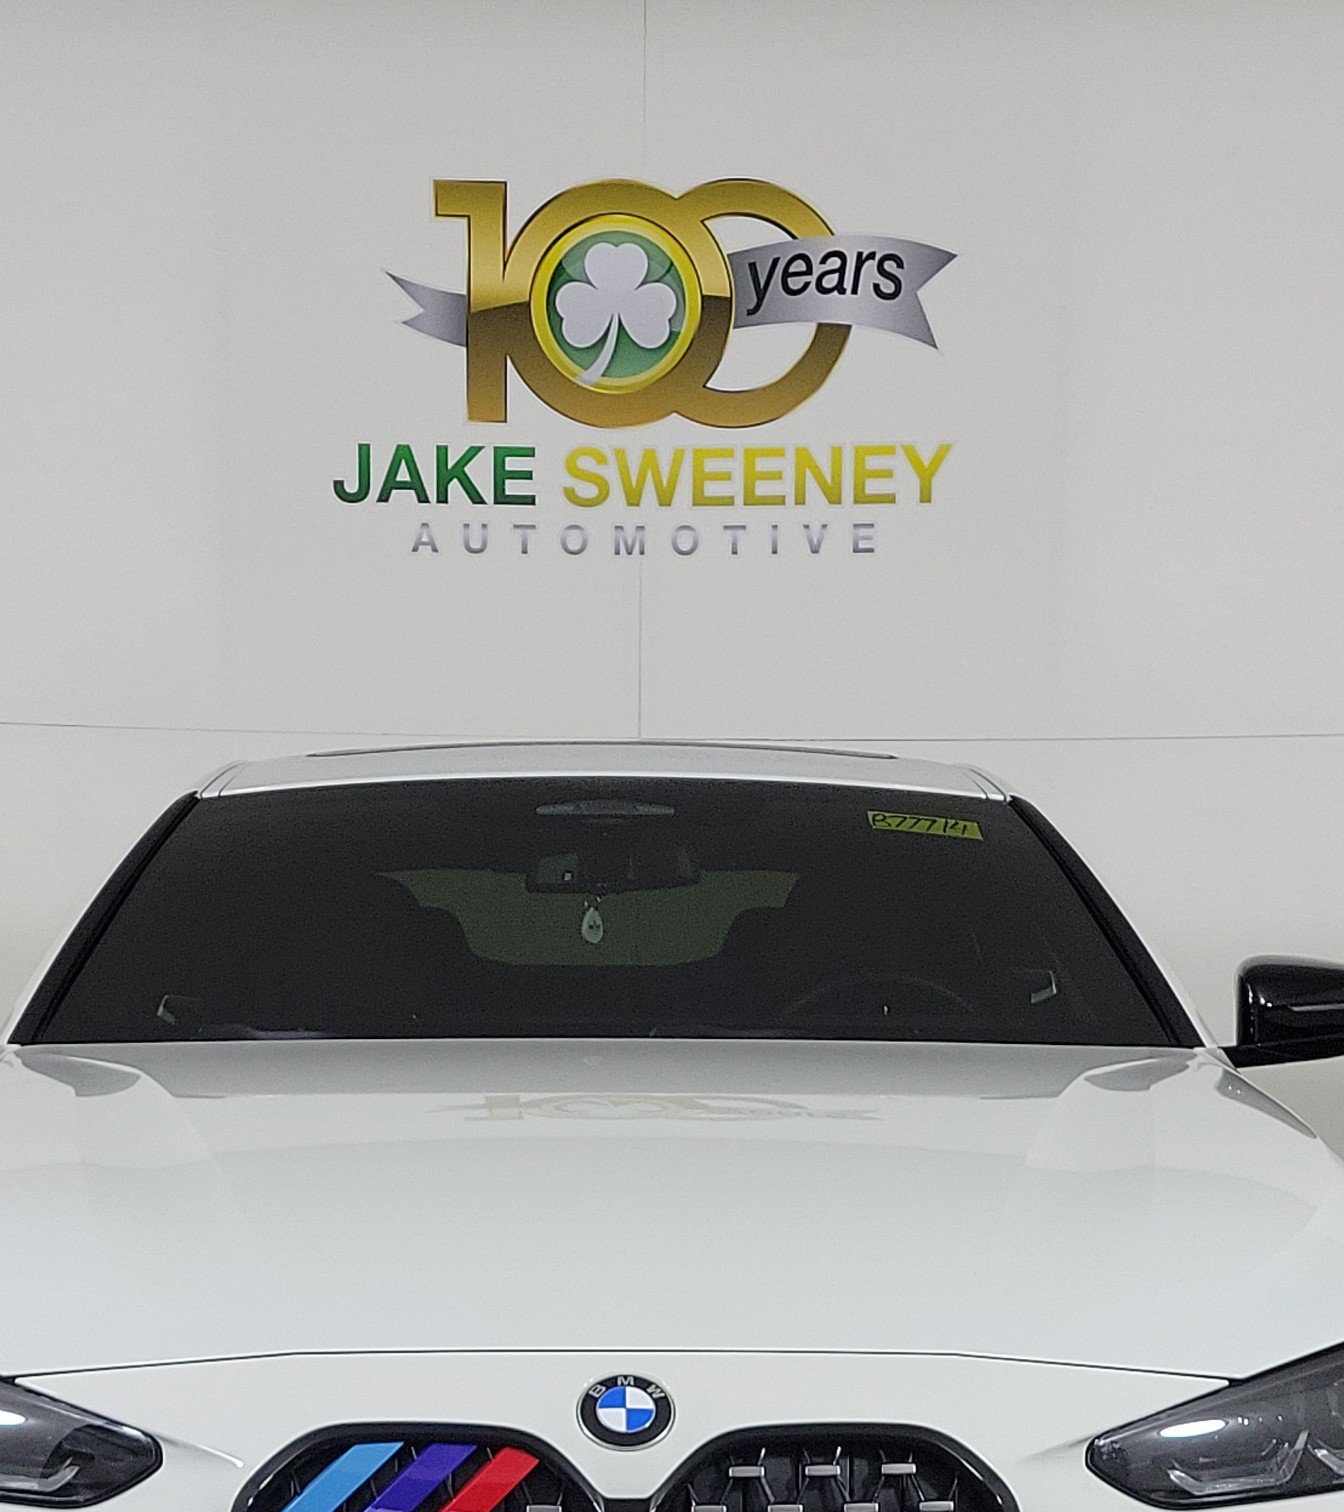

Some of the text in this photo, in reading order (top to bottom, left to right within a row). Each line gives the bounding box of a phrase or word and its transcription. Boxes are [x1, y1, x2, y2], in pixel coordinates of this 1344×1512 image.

[432, 177, 905, 429] 100 years
[331, 442, 953, 508] JAKE SWEENEY
[411, 522, 876, 556] AUTOMOTIVE
[587, 1375, 666, 1399] BMW
